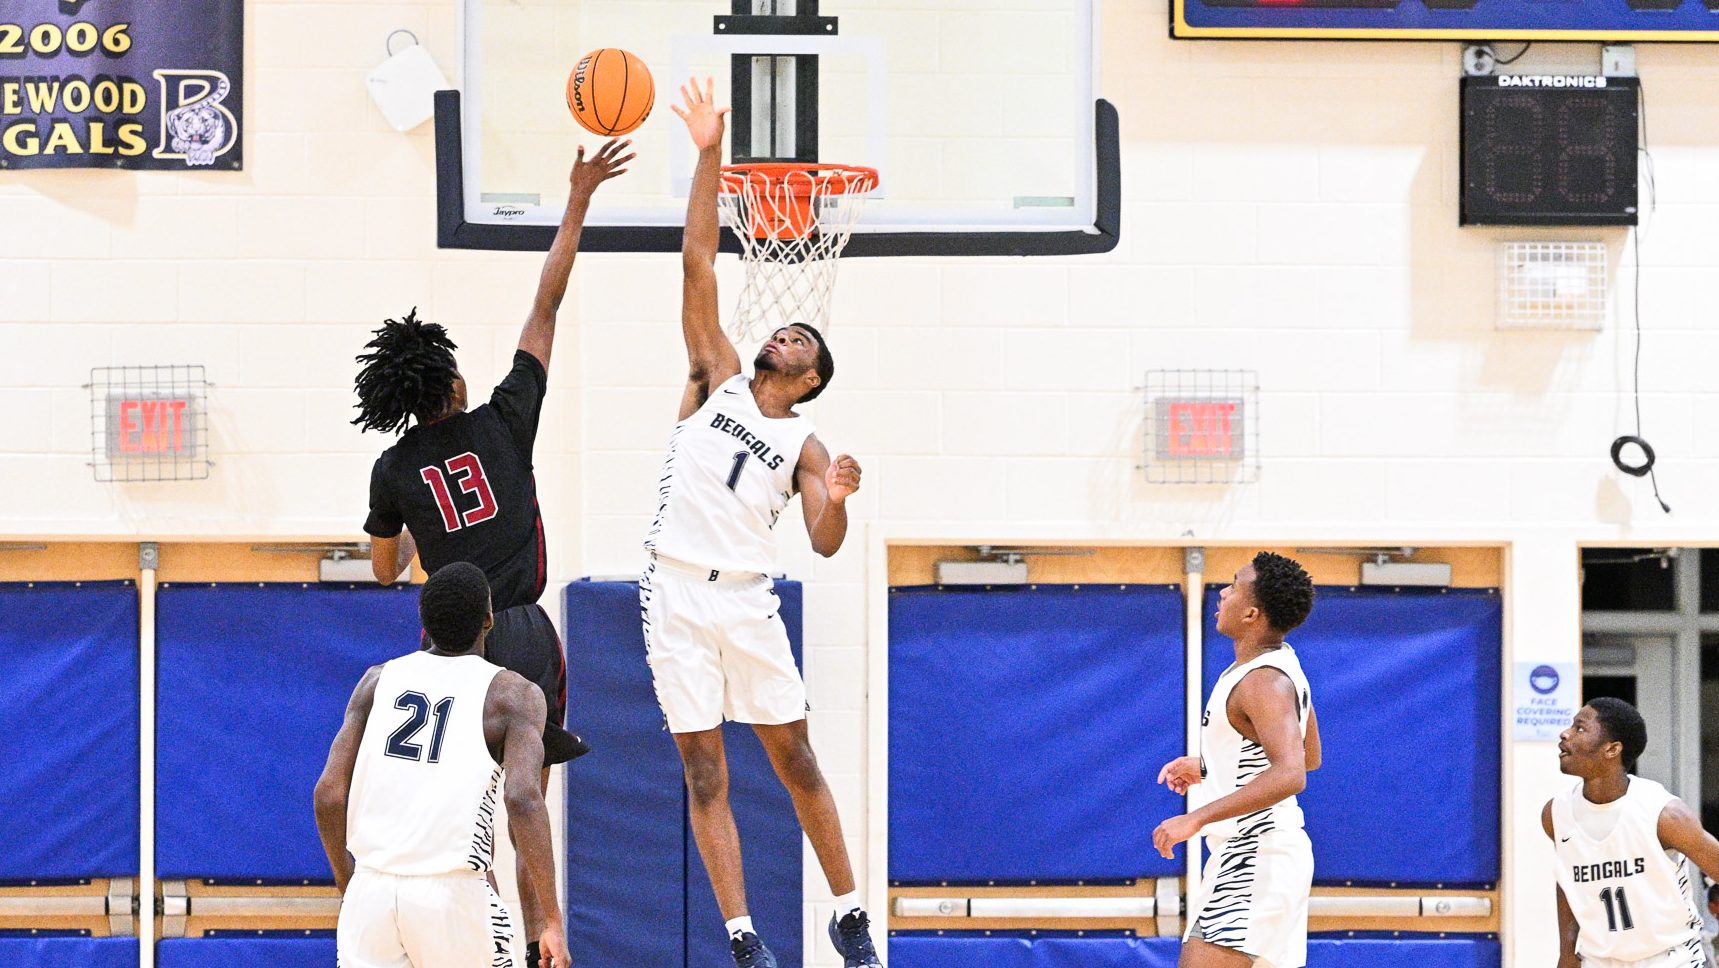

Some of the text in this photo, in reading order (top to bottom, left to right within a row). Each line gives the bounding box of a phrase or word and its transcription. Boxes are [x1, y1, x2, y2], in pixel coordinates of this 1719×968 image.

[0, 22, 131, 53] 2006
[3, 80, 147, 115] EWOOD
[573, 56, 593, 112] Wilson
[1498, 75, 1608, 88] DAKTRONICS
[2, 122, 147, 156] GALS
[493, 206, 525, 217] Jaypro
[119, 400, 186, 453] EXIT
[1168, 403, 1235, 455] EXIT
[726, 450, 750, 493] 1
[419, 451, 499, 533] 13
[707, 569, 720, 582] B
[1516, 707, 1572, 716] COVERING
[1531, 698, 1558, 706] FACE
[383, 689, 455, 764] 21
[1516, 717, 1571, 726] REQUIRED
[1573, 857, 1645, 883] BENGALS
[1599, 886, 1635, 932] 11
